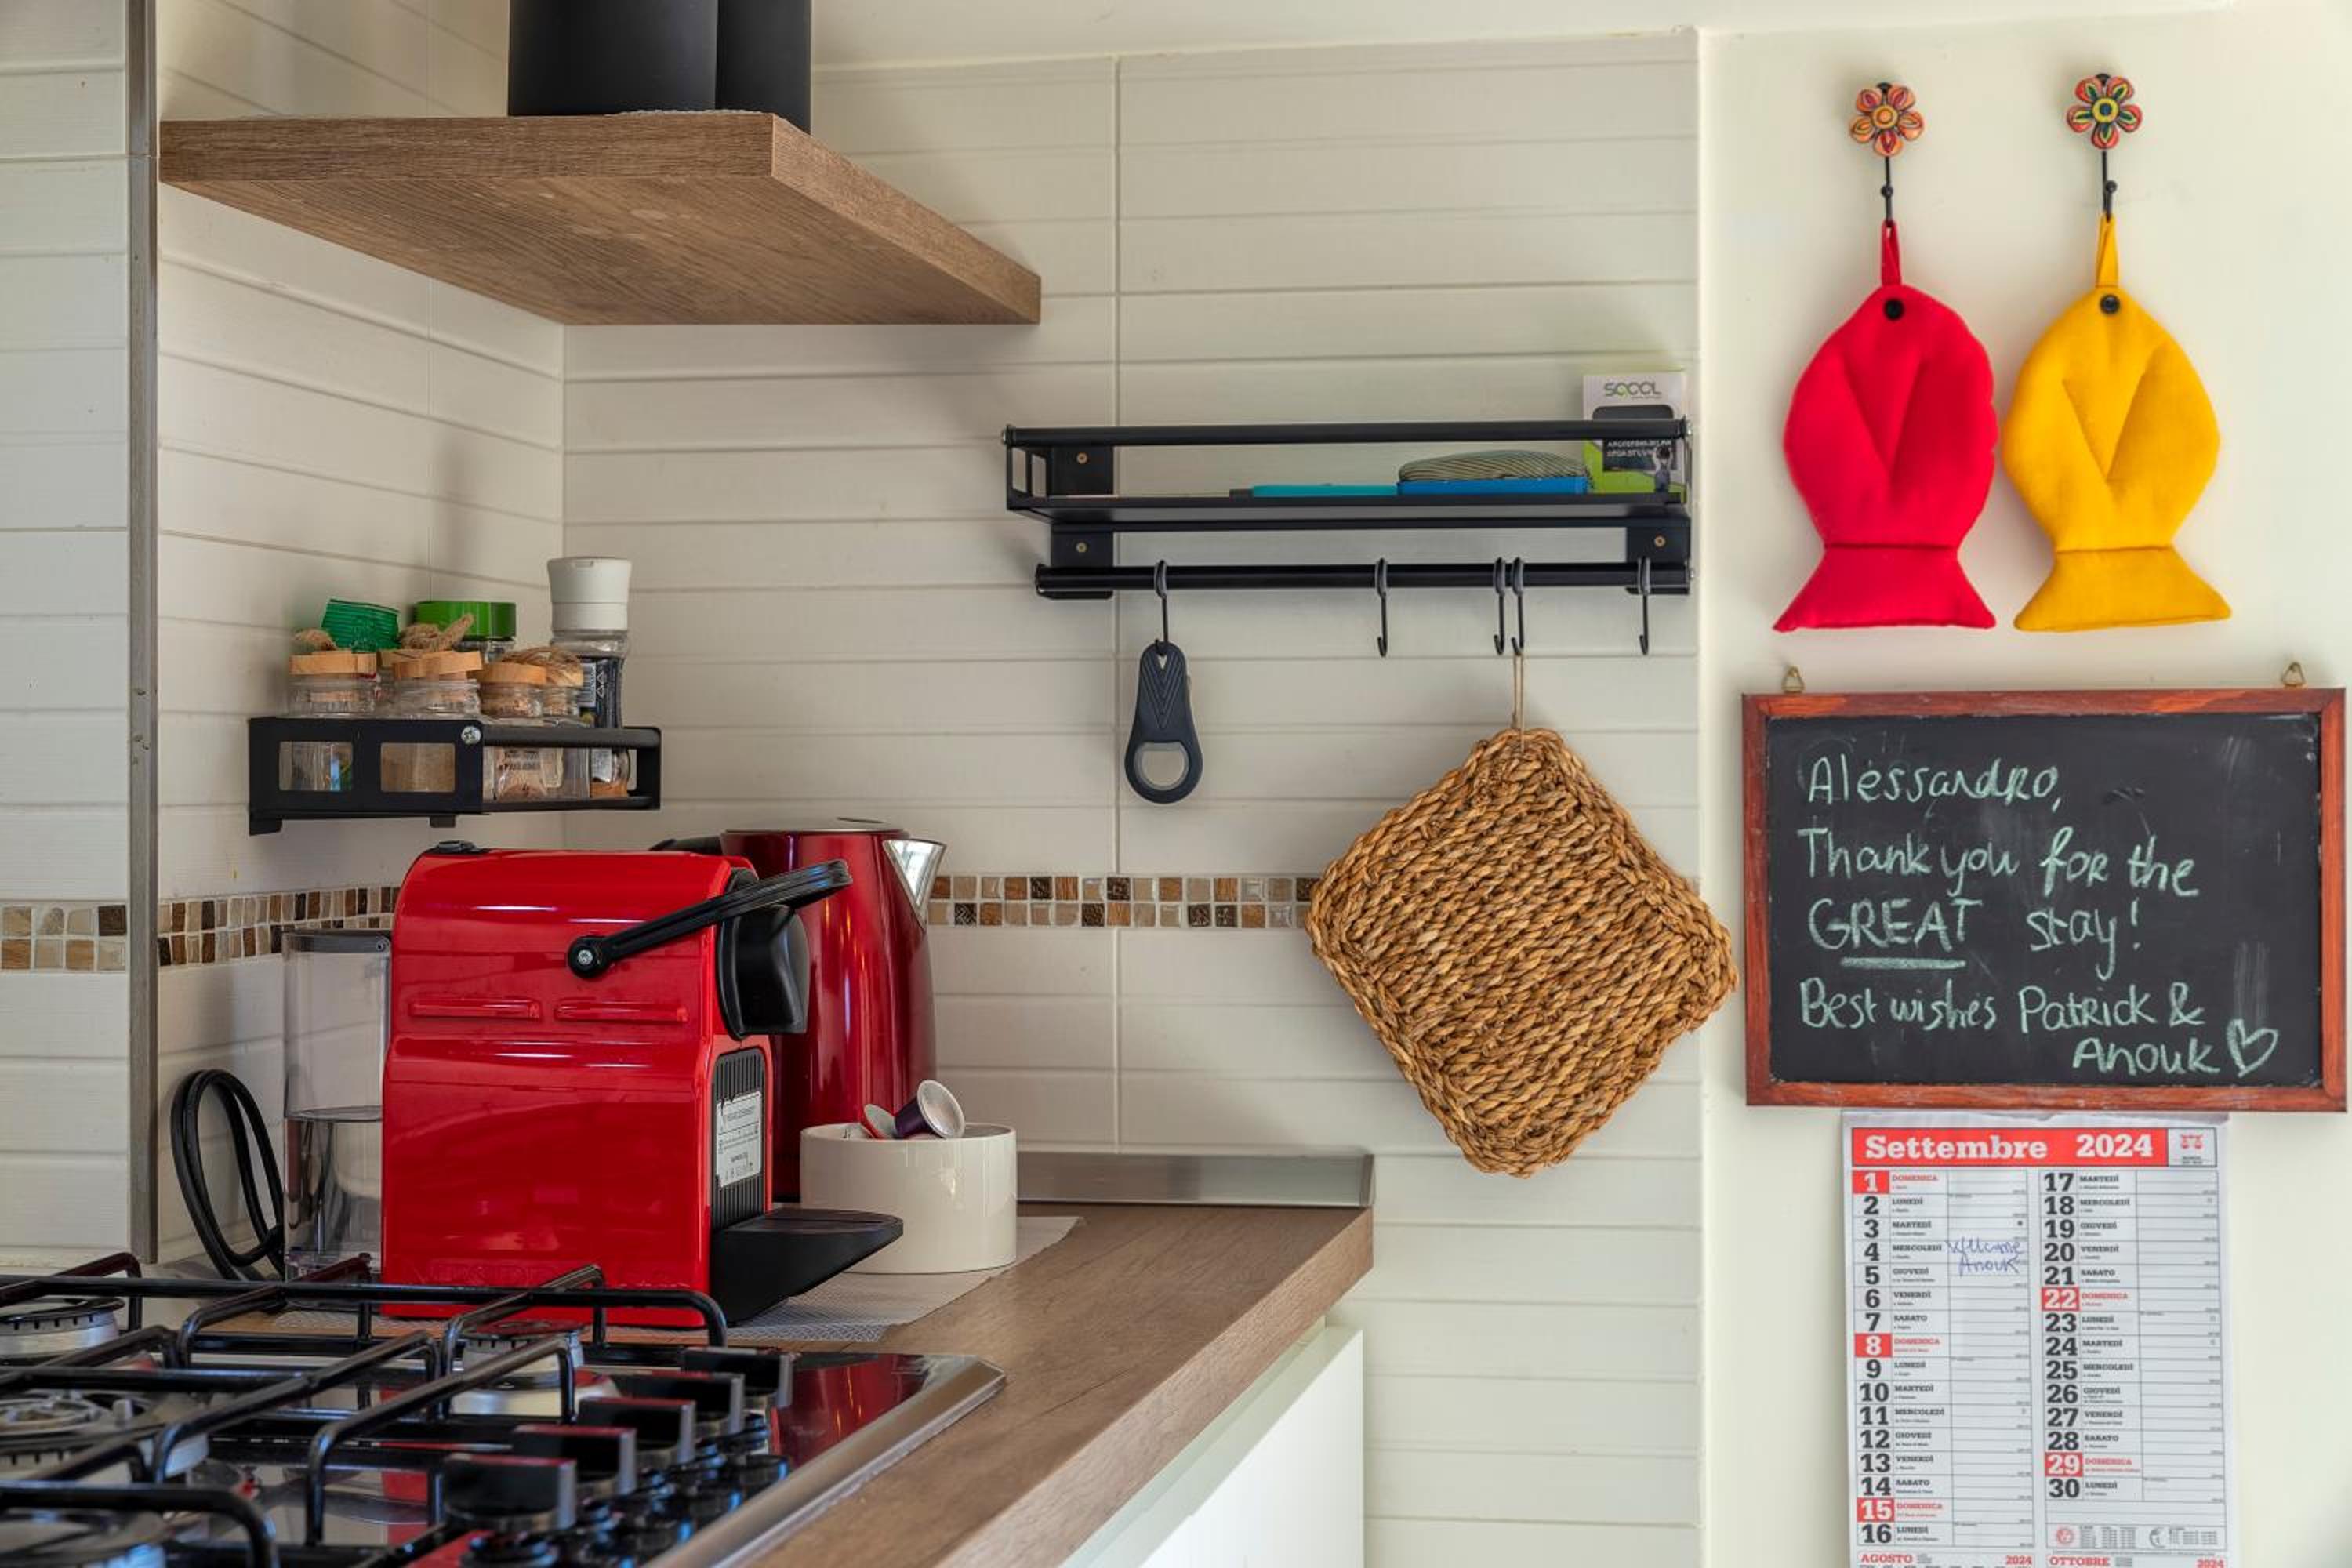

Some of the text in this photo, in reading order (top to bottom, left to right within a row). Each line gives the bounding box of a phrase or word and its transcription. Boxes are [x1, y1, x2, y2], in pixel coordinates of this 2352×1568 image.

[1798, 828, 1932, 879] Thank
[1941, 844, 2020, 897] you
[2127, 836, 2199, 896] the
[1809, 898, 1983, 951] GREAT
[1800, 977, 1878, 1028] Best
[1890, 978, 1998, 1032] wishes
[2169, 981, 2205, 1027] &
[2074, 1038, 2220, 1075] Anouk
[1865, 1134, 2154, 1160] Settembre 2024
[1864, 1173, 1878, 1192] 1
[2044, 1173, 2074, 1192] 17
[1864, 1196, 1879, 1215] 2
[2044, 1196, 2074, 1215] 18
[1864, 1219, 1879, 1239] 3
[2044, 1219, 2075, 1239] 19
[1864, 1243, 1880, 1261] 4
[2044, 1243, 2075, 1262] 20
[1865, 1266, 1880, 1285] 5
[2044, 1266, 2074, 1286] 21
[1865, 1289, 1881, 1308] 6
[2044, 1289, 2077, 1309] 22
[1865, 1312, 1881, 1332] 7
[2045, 1313, 2077, 1333] 23
[1866, 1336, 1882, 1356] 8
[2045, 1337, 2078, 1356] 24
[1866, 1359, 1881, 1378] 9
[2046, 1360, 2078, 1380] 25
[1860, 1383, 1889, 1402] 10
[2046, 1384, 2078, 1403] 26
[1860, 1406, 1889, 1425] 11
[2047, 1408, 2079, 1427] 27
[1860, 1430, 1890, 1449] 12
[2047, 1431, 2079, 1451] 28
[1860, 1454, 1891, 1473] 13
[2048, 1455, 2081, 1475] 29
[1861, 1476, 1891, 1496] 14
[2049, 1478, 2080, 1498] 30
[1861, 1500, 1893, 1521] 15
[1862, 1524, 1892, 1543] 16
[1861, 1555, 1913, 1563] AGOSTO
[2006, 1555, 2032, 1565] 2024
[2049, 1557, 2110, 1566] OTTOBRE
[2197, 1559, 2224, 1568] 2024
